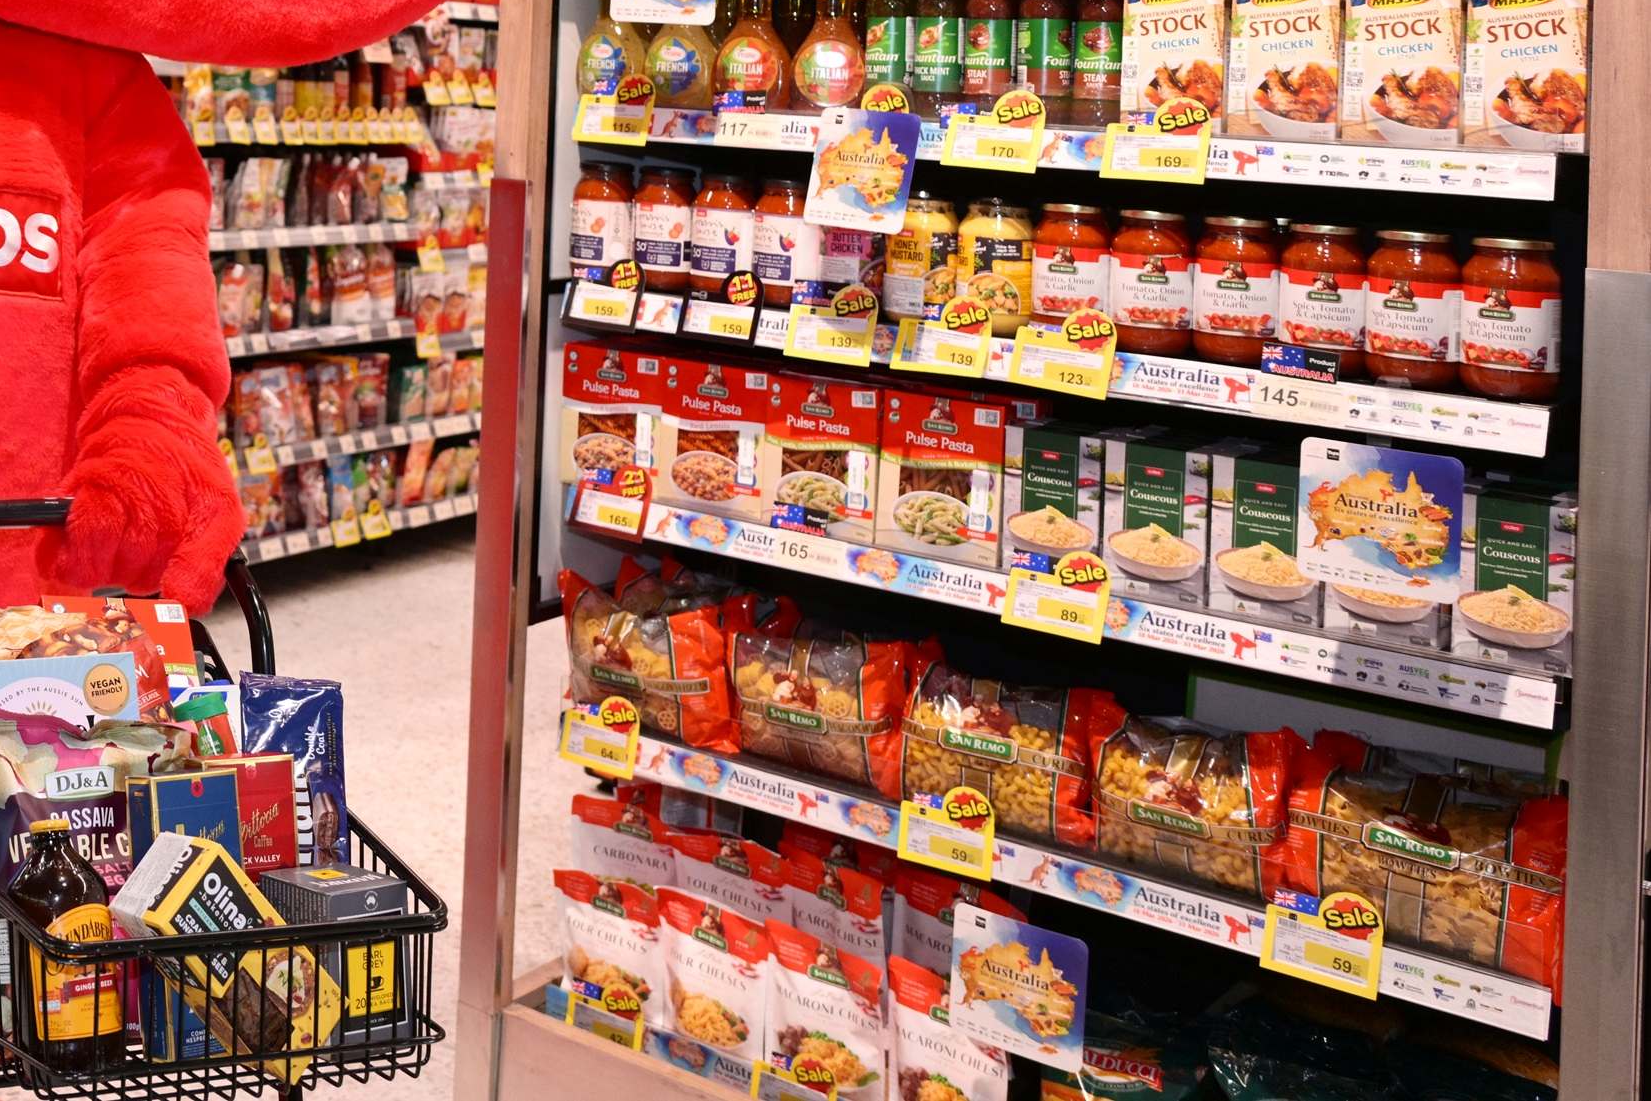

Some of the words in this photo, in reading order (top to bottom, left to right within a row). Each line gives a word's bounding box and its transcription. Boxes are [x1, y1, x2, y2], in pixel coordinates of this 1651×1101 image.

[1139, 9, 1186, 21] AUSTRALIAN
[1187, 5, 1216, 15] OWNED
[1139, 14, 1208, 37] STOCK
[1249, 15, 1323, 38] STOCK
[1363, 16, 1443, 41] STOCK
[1487, 16, 1567, 44] STOCK
[1151, 37, 1201, 51] CHICKEN
[1261, 38, 1314, 52] CHICKEN
[1376, 42, 1434, 56] CHICKEN
[1500, 44, 1559, 59] CHICKEN
[587, 59, 616, 70] FRENCH
[656, 61, 689, 73] FRENCH
[729, 63, 763, 76] ITALIAN
[967, 69, 987, 78] STEAK
[1083, 73, 1107, 83] STEAK
[617, 83, 653, 100] Sale
[997, 100, 1042, 124] Sale
[1158, 106, 1208, 133] Sale
[720, 122, 747, 138] 117
[834, 149, 886, 167] Australia
[990, 146, 1015, 159] 170
[1154, 155, 1183, 168] 169
[893, 240, 918, 252] HONEY
[891, 249, 924, 263] MUSTARD
[1068, 277, 1095, 285] Onion
[595, 306, 613, 316] 159
[835, 295, 876, 316] Sale
[1292, 300, 1315, 313] Spicy
[1318, 303, 1356, 316] Tomato
[945, 308, 989, 331] Sale
[1381, 320, 1428, 333] Capsicum
[1066, 320, 1113, 342] Sale
[1475, 329, 1527, 343] Capsicum
[1309, 357, 1337, 368] Product
[1058, 372, 1084, 385] 123
[1134, 361, 1221, 387] Australia
[1271, 363, 1335, 383] AUSTRALIA
[583, 380, 609, 395] Pulse
[612, 384, 640, 399] Pasta
[1260, 385, 1299, 408] 145
[682, 396, 711, 412] Pulse
[713, 400, 742, 417] Pasta
[786, 415, 816, 431] Pulse
[818, 420, 850, 436] Pasta
[905, 431, 937, 448] Pulse
[940, 437, 974, 454] Pasta
[1027, 472, 1072, 488] Couscous
[1130, 489, 1178, 505] Couscous
[1334, 493, 1419, 518] Australia
[609, 513, 628, 527] 165
[1239, 506, 1291, 523] Couscous
[778, 541, 809, 560] 165
[1483, 546, 1541, 564] Couscous
[907, 562, 983, 592] Australia
[1061, 568, 1106, 585] Sale
[1061, 609, 1077, 622] 89
[1140, 609, 1227, 641] Australia
[90, 676, 122, 689] VEGAN
[91, 685, 123, 697] FRIENDLY
[43, 686, 68, 698] AUSSIE
[71, 694, 84, 707] SUN
[602, 706, 636, 726] Sale
[304, 725, 316, 759] Double
[315, 731, 326, 755] Coat
[950, 732, 969, 747] SAN
[971, 737, 1008, 754] REMO
[56, 770, 109, 793] DJ&A
[729, 768, 796, 801] Australia
[946, 798, 989, 821] Sale
[1137, 807, 1162, 823] SAN
[1164, 815, 1199, 833] REMO
[1289, 810, 1351, 836] BOWTIES
[254, 835, 273, 847] Coffee
[1225, 828, 1274, 843] CURLS
[1374, 829, 1401, 847] SAN
[1404, 838, 1446, 859] REMO
[254, 854, 280, 863] VALLEY
[593, 843, 668, 872] CARBONARA
[950, 847, 968, 863] 59
[1134, 885, 1221, 922] Australia
[1325, 908, 1378, 928] Sale
[363, 950, 384, 960] EARL
[210, 958, 229, 980] SEED
[1331, 955, 1354, 973] 59
[981, 959, 1049, 992] Australia
[356, 997, 367, 1009] 20
[605, 997, 640, 1012] Sale
[794, 1066, 832, 1083] Sale
